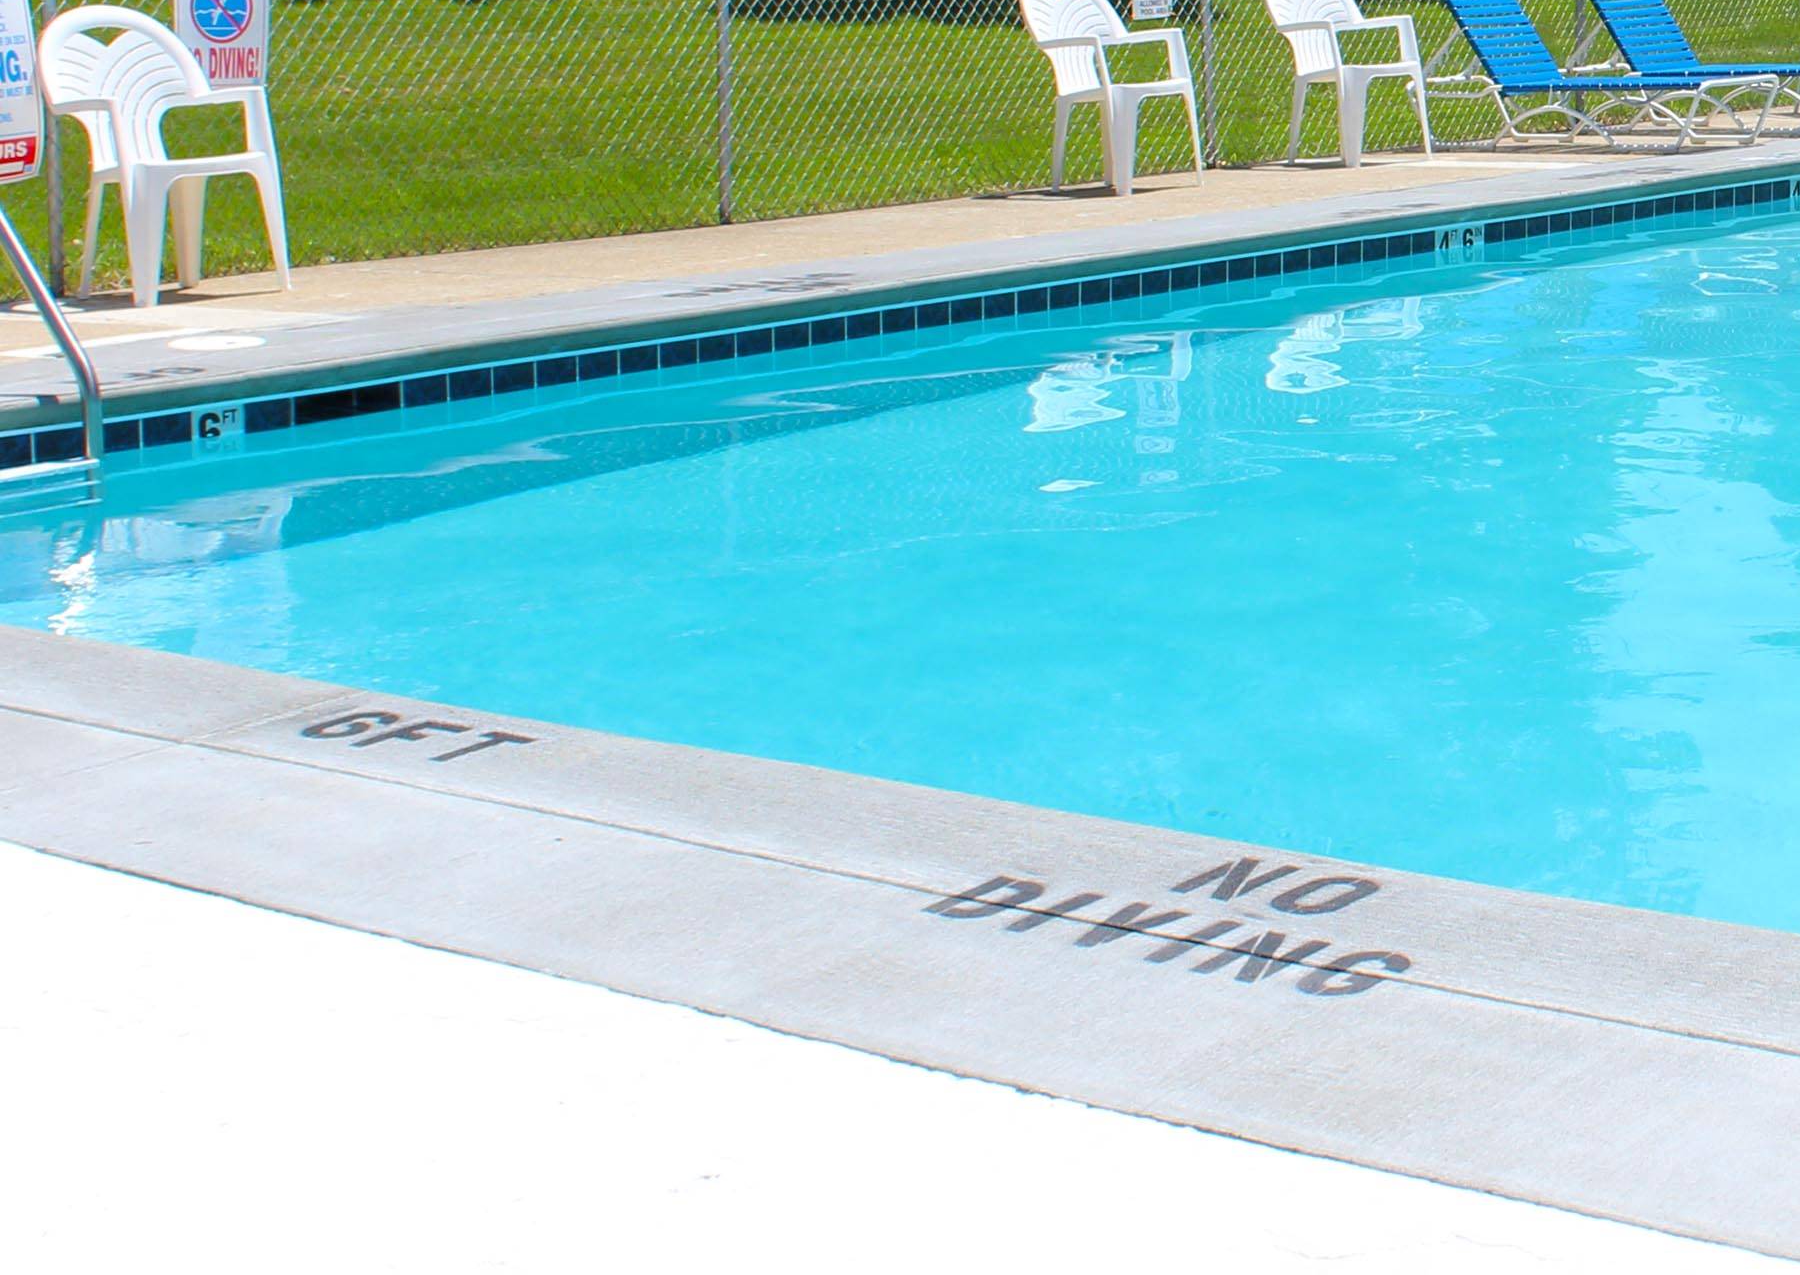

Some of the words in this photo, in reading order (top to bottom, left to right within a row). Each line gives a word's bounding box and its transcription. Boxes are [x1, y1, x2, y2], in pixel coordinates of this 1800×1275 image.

[209, 47, 260, 79] DIVING!
[296, 704, 541, 766] 6FT
[1172, 855, 1386, 918] NO
[922, 874, 1413, 999] DIVING
